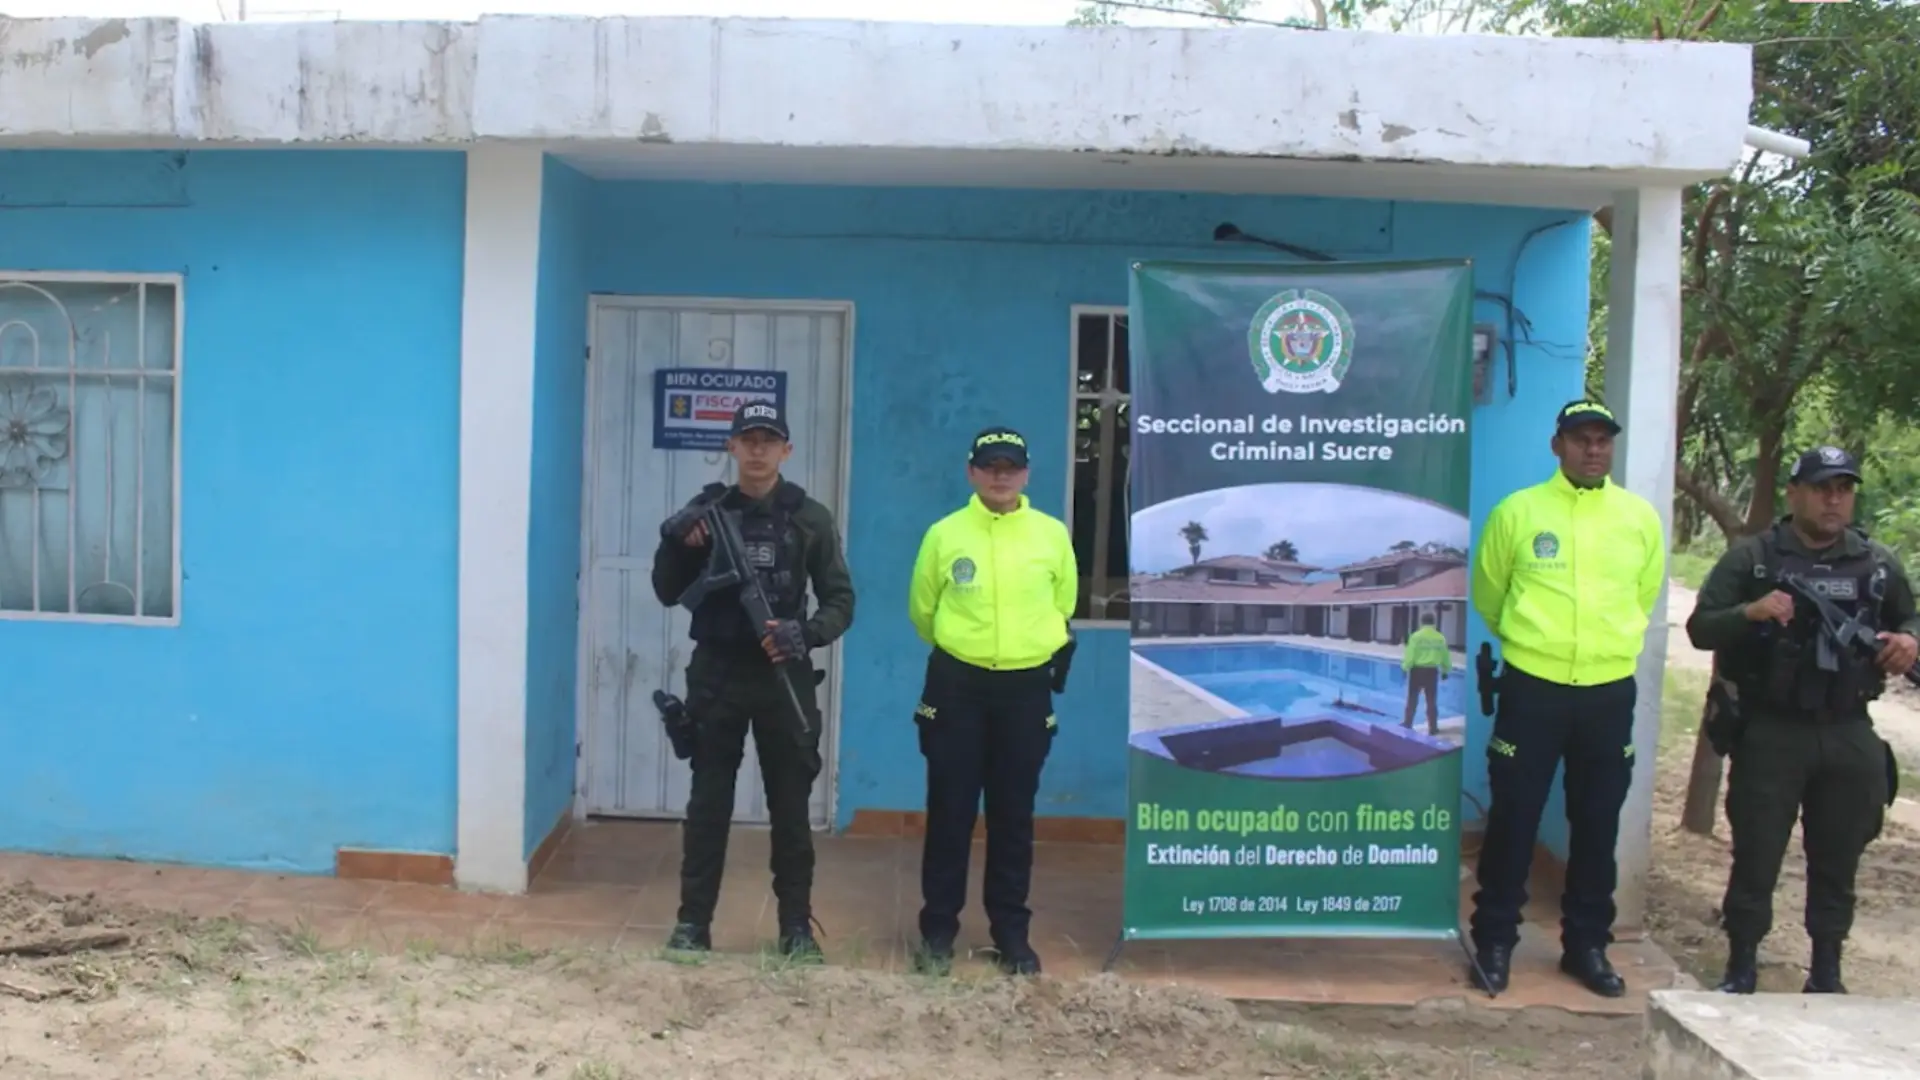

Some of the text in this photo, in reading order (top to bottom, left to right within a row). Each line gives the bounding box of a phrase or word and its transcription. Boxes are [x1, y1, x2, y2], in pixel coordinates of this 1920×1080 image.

[666, 373, 777, 389] BIEN OCUPADO
[1137, 413, 1465, 437] Seccional de Investigación
[1210, 441, 1393, 461] Criminal Sucre
[1809, 581, 1854, 596] OES
[1137, 802, 1450, 837] Bien ocupado con fines de
[1147, 843, 1438, 866] Extinción del Derecho de Dominio
[1183, 896, 1287, 914] Ley 1708 de 2014
[1296, 896, 1402, 914] Ley 1849 de 2017
